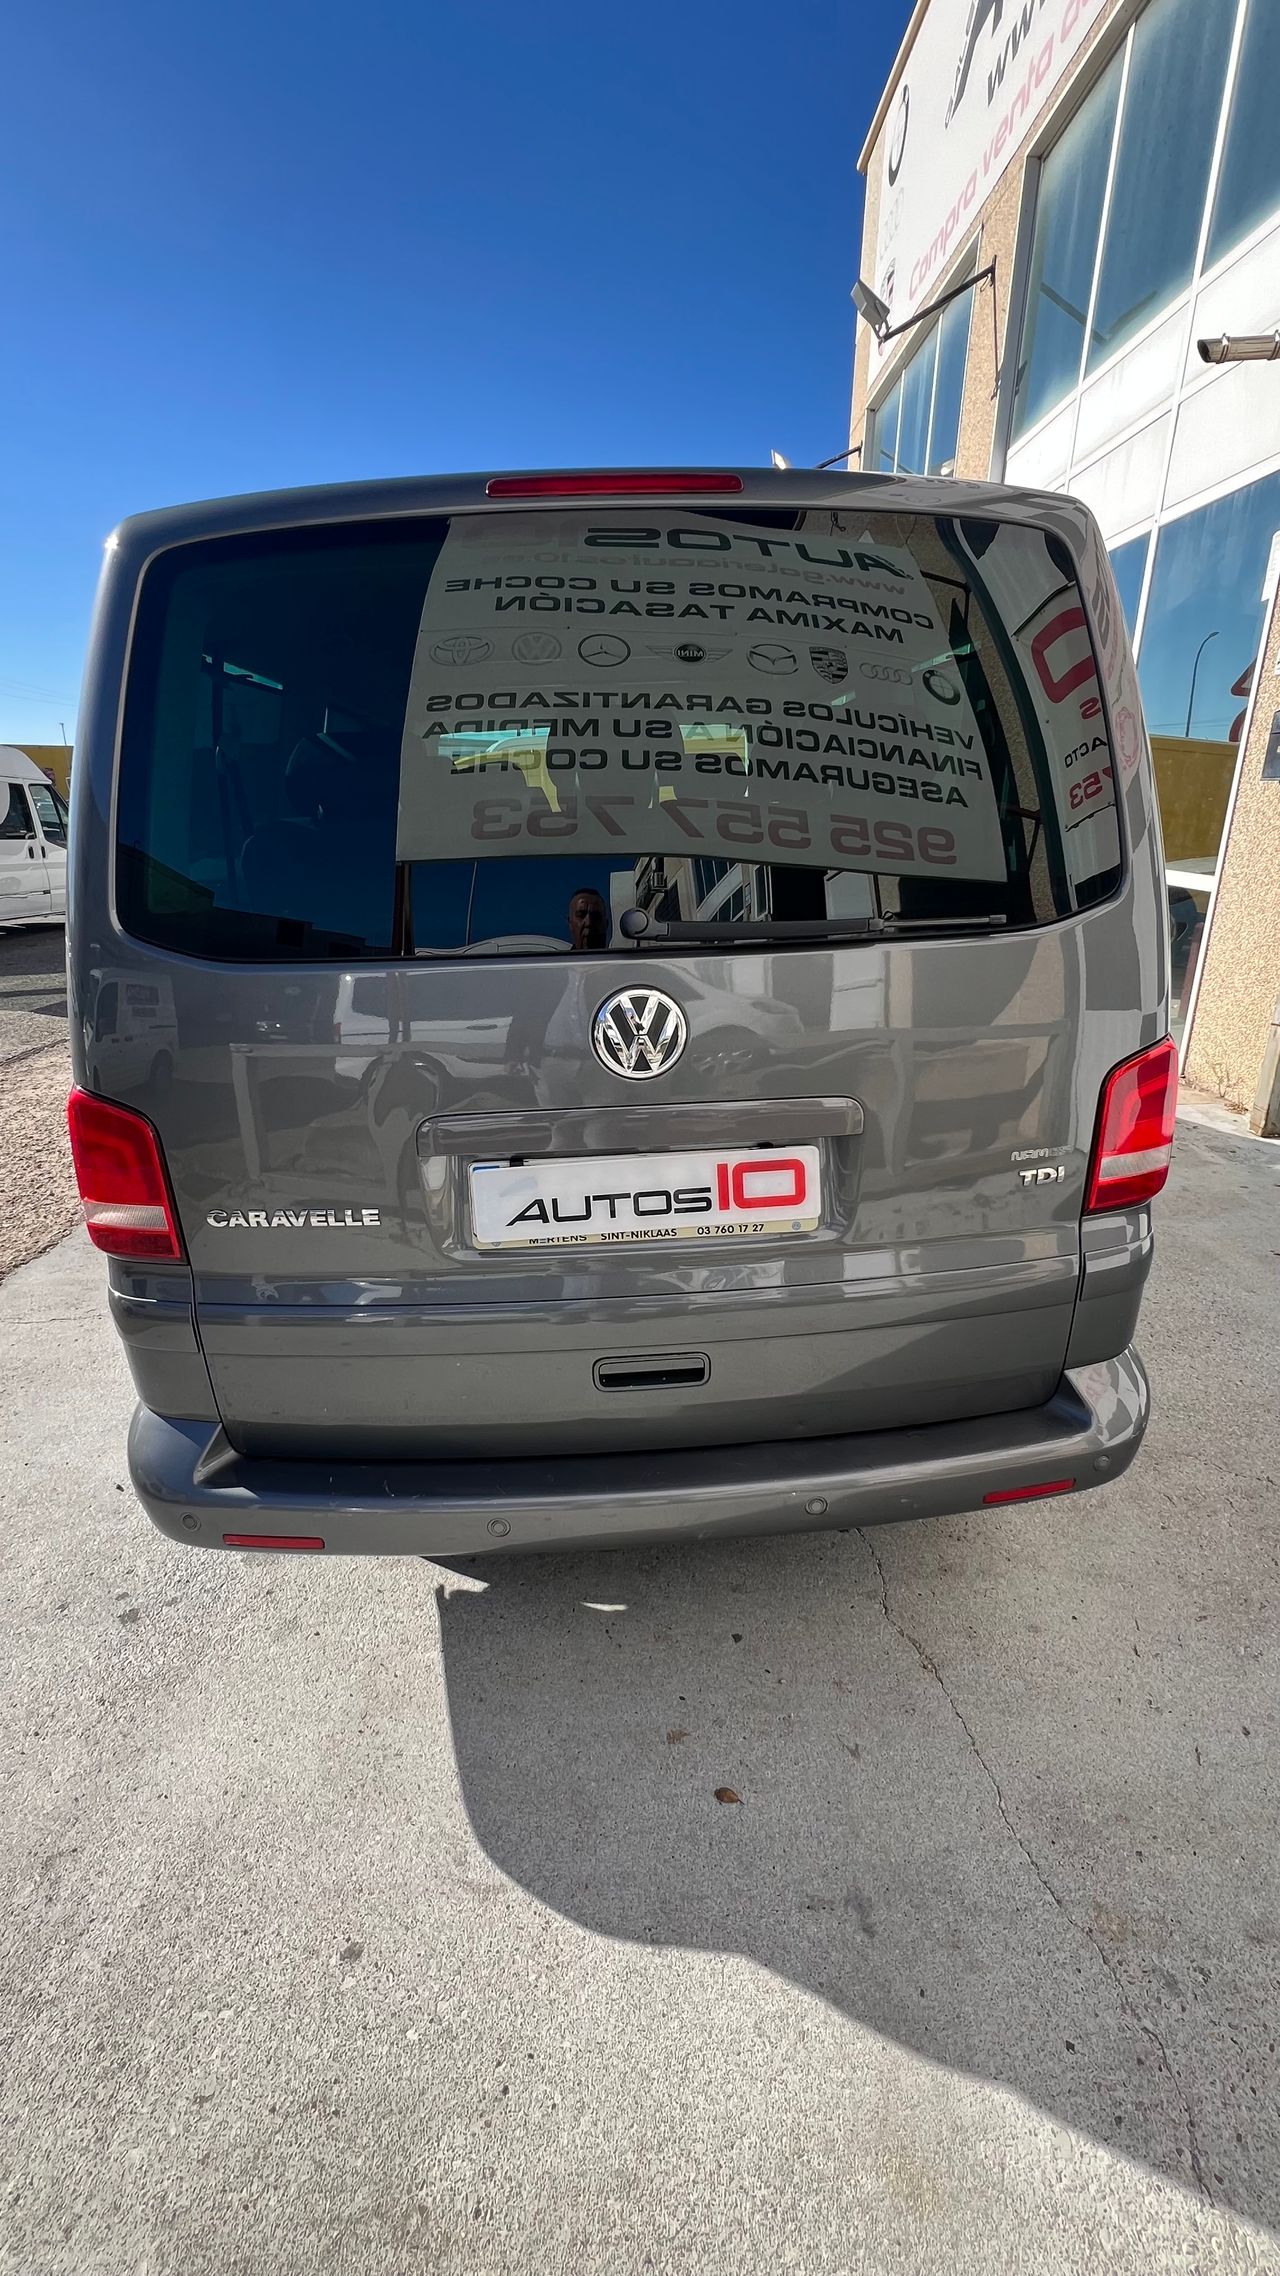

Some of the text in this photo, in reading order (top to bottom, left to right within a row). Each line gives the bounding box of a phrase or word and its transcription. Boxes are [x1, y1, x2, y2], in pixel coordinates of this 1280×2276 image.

[983, 32, 1055, 177] venta
[1019, 1165, 1065, 1187] TDI
[206, 1208, 381, 1229] CARAVELLE
[600, 1228, 678, 1242] SINT-NIKLAAS
[697, 1226, 711, 1236] 03
[715, 1225, 735, 1235] 760
[738, 1224, 749, 1234] 17
[752, 1223, 765, 1233] 27
